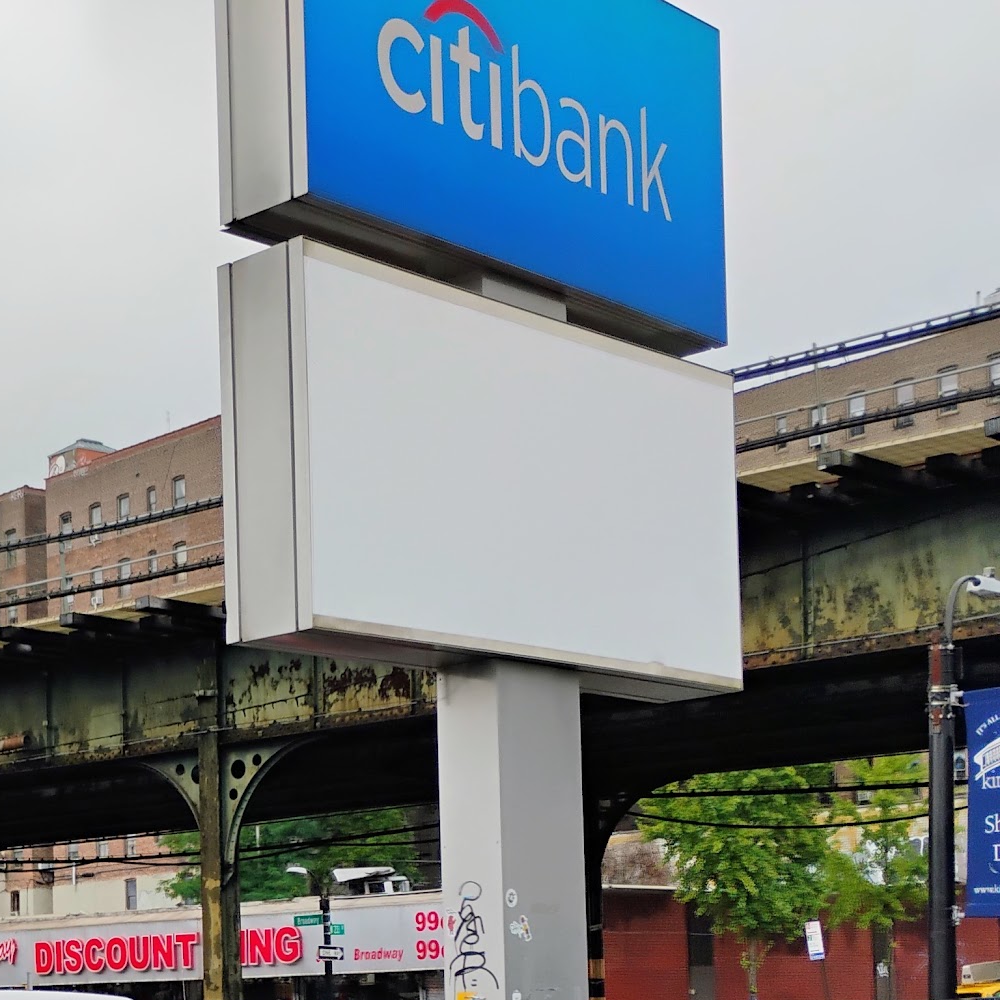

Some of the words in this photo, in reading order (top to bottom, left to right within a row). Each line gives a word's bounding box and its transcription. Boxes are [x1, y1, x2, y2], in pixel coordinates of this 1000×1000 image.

[377, 18, 672, 222] citibank
[297, 916, 320, 926] Broadway
[415, 911, 444, 931] 99
[34, 932, 198, 976] DISCOUNT
[240, 926, 303, 966] ING
[354, 948, 404, 961] Broadway
[416, 940, 444, 960] 99
